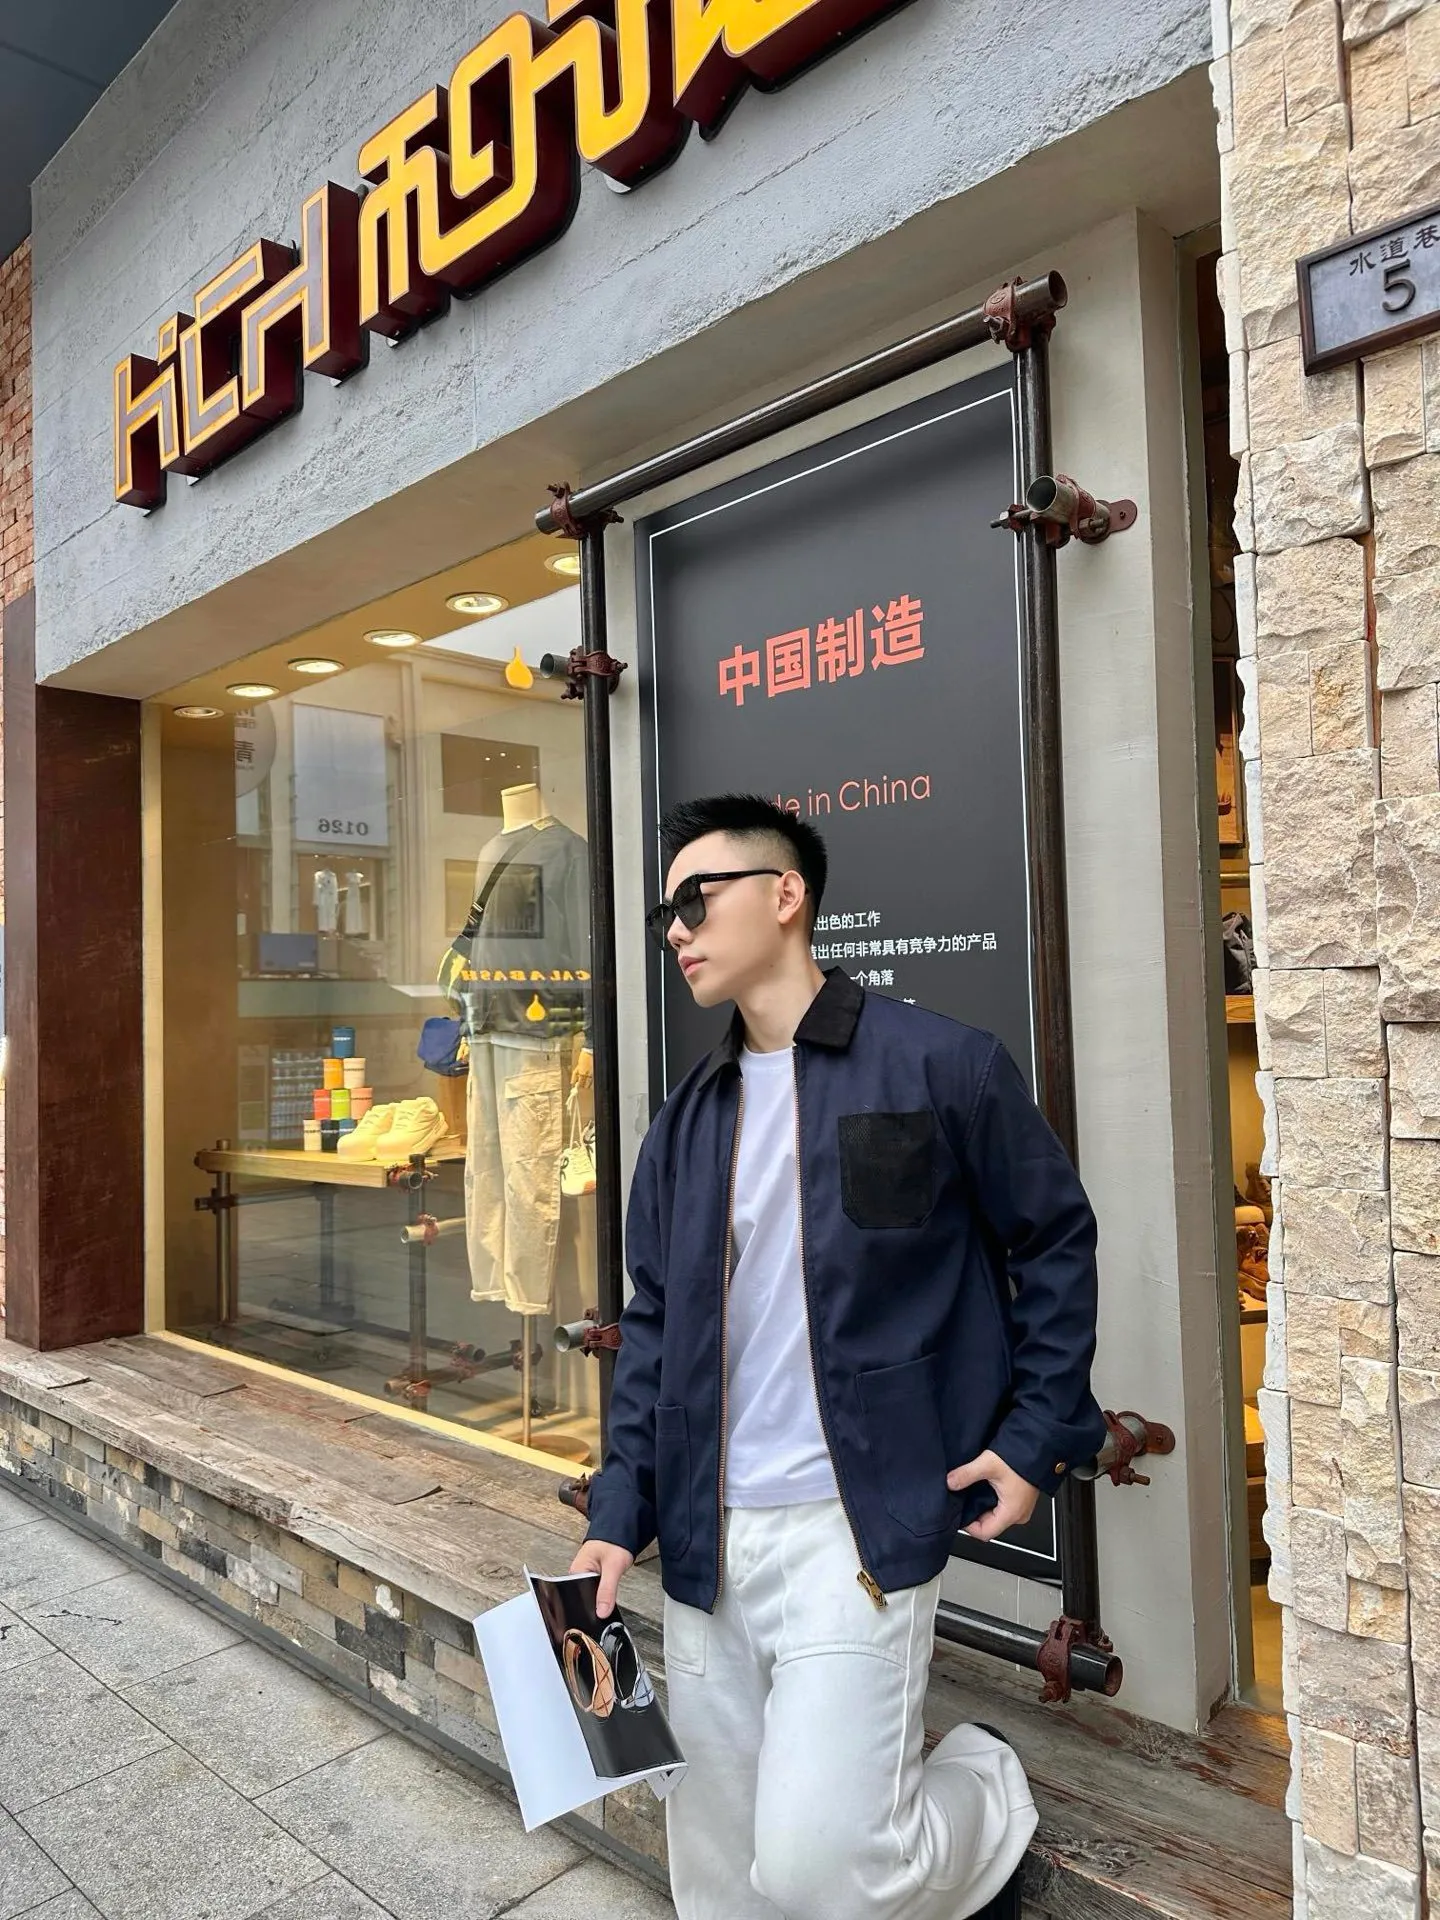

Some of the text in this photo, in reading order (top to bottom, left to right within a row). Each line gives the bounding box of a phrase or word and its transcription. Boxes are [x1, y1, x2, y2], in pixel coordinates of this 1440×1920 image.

[1349, 225, 1440, 277] 水道巷
[1382, 258, 1417, 313] 5
[718, 594, 925, 707] 中国制造
[807, 788, 831, 816] in
[838, 774, 931, 811] China
[813, 911, 881, 931] 出色的工作
